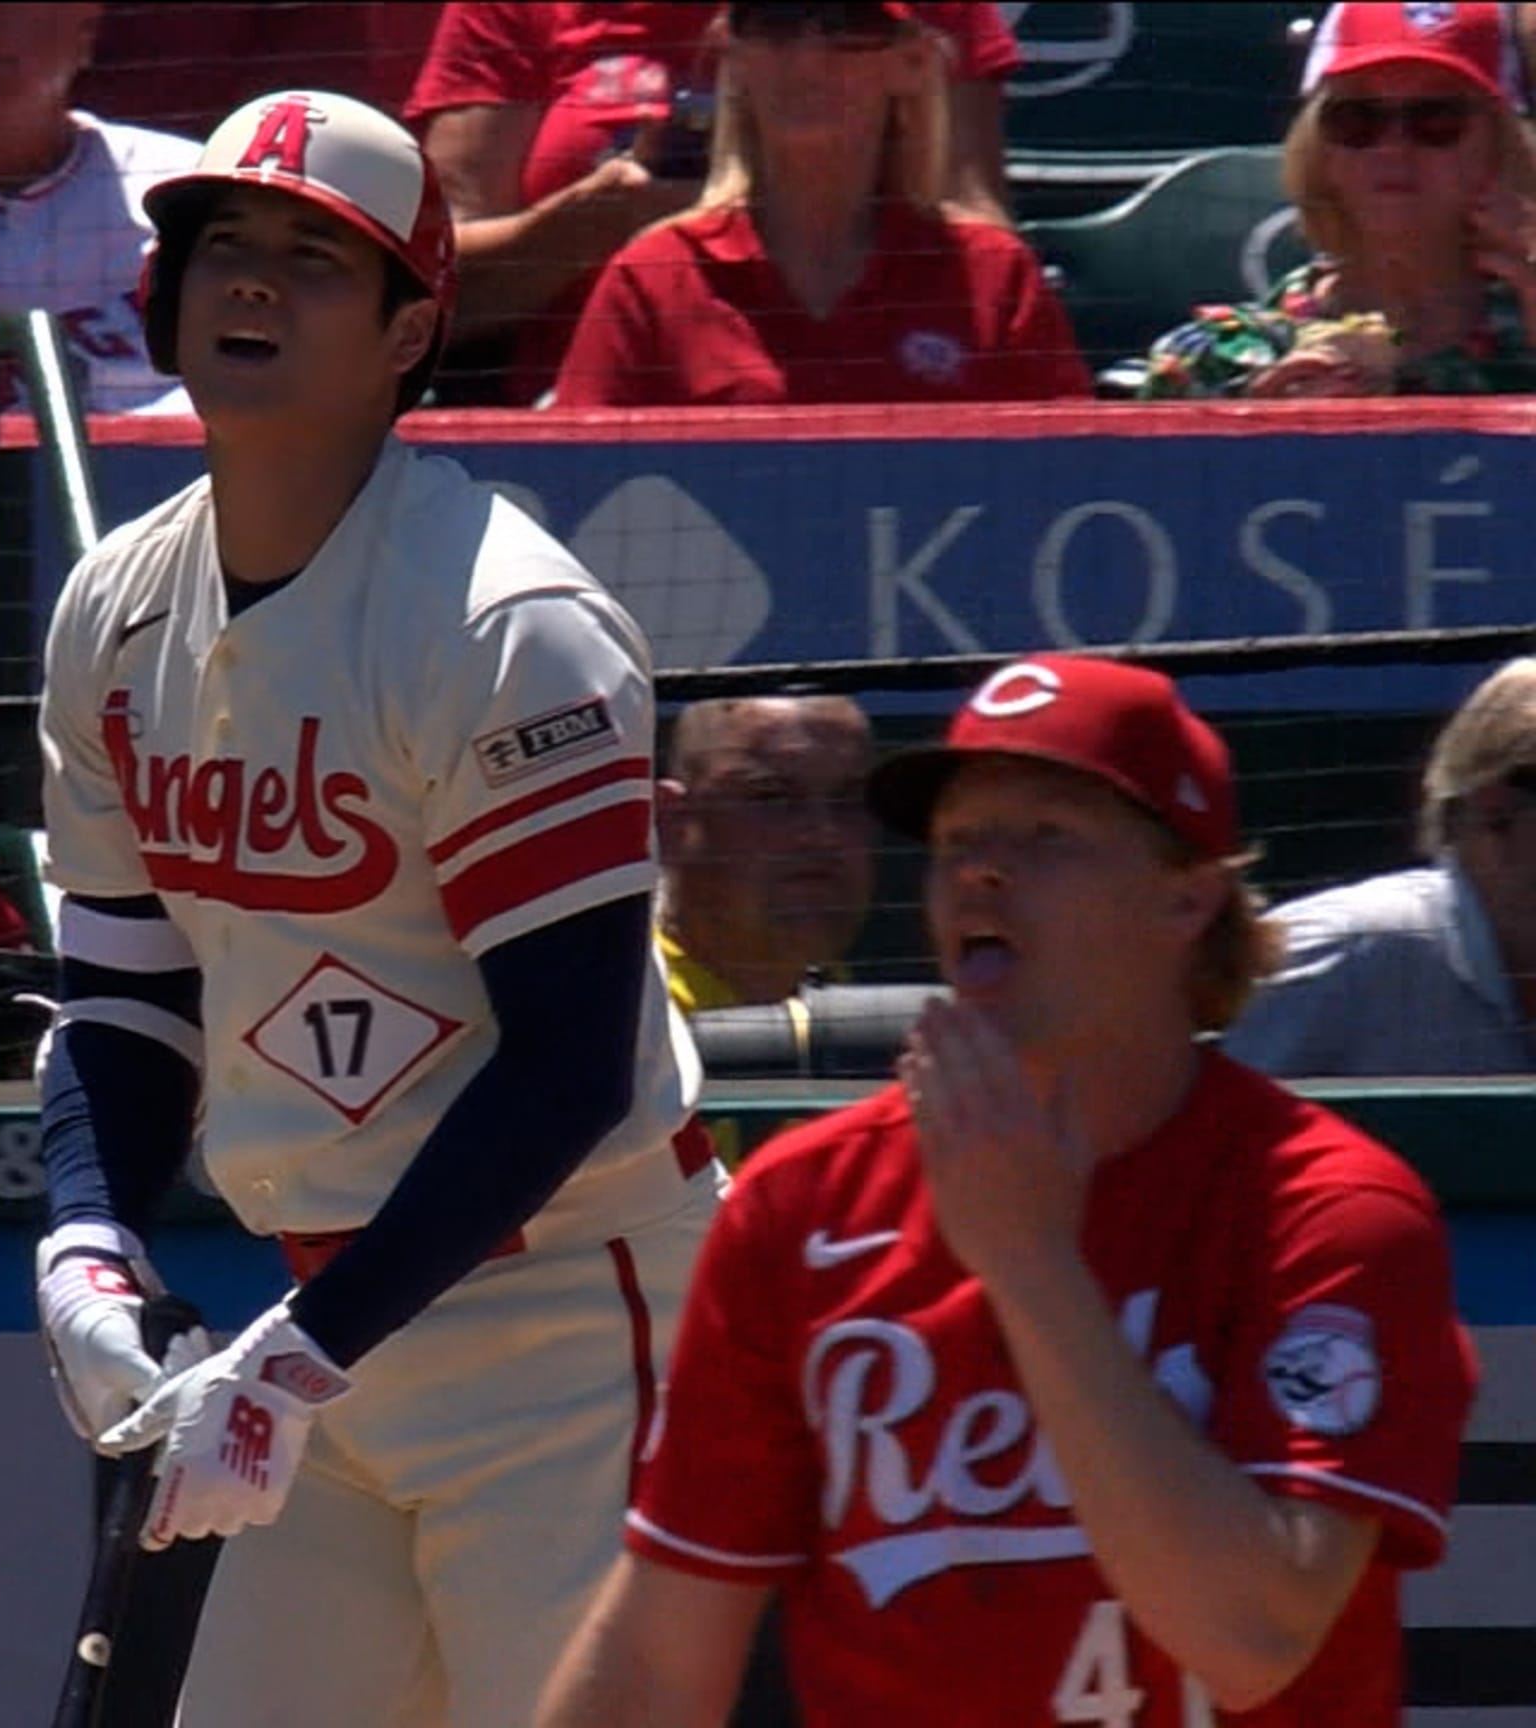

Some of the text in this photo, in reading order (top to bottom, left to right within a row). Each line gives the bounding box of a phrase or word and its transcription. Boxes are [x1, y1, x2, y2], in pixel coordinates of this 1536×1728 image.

[869, 456, 1495, 660] KOSÉ
[971, 664, 1061, 716] C
[529, 706, 603, 752] FBM
[303, 998, 375, 1079] 17
